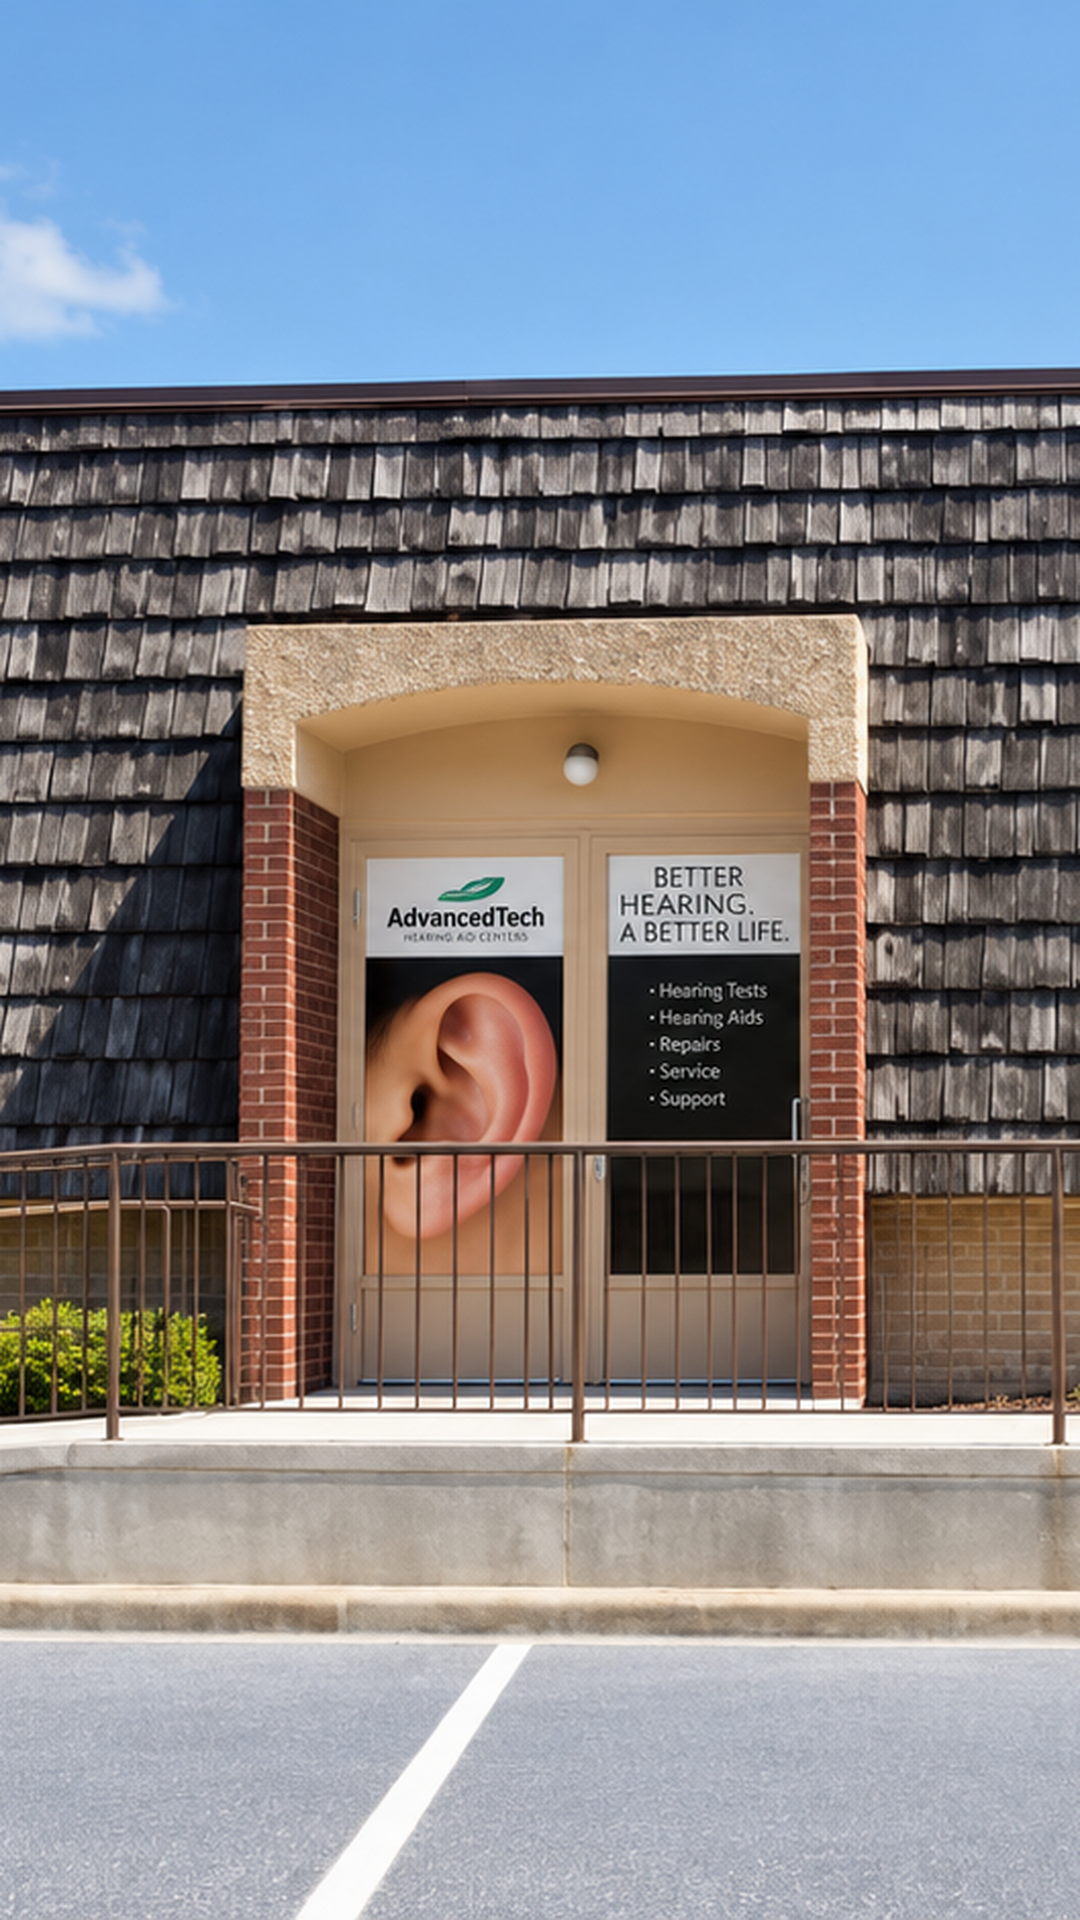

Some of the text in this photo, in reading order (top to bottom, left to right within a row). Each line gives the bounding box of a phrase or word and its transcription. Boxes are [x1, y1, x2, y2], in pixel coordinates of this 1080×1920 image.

[654, 865, 744, 888] BETTER
[620, 893, 755, 916] HEARING.
[387, 906, 545, 928] AdvancedTech
[619, 920, 790, 942] A BETTER LIFE.
[659, 981, 768, 1003] Hearing Tests
[659, 1008, 765, 1030] Hearing Aids
[659, 1036, 721, 1055] Repairs
[659, 1062, 721, 1080] Service
[659, 1089, 726, 1111] Support
